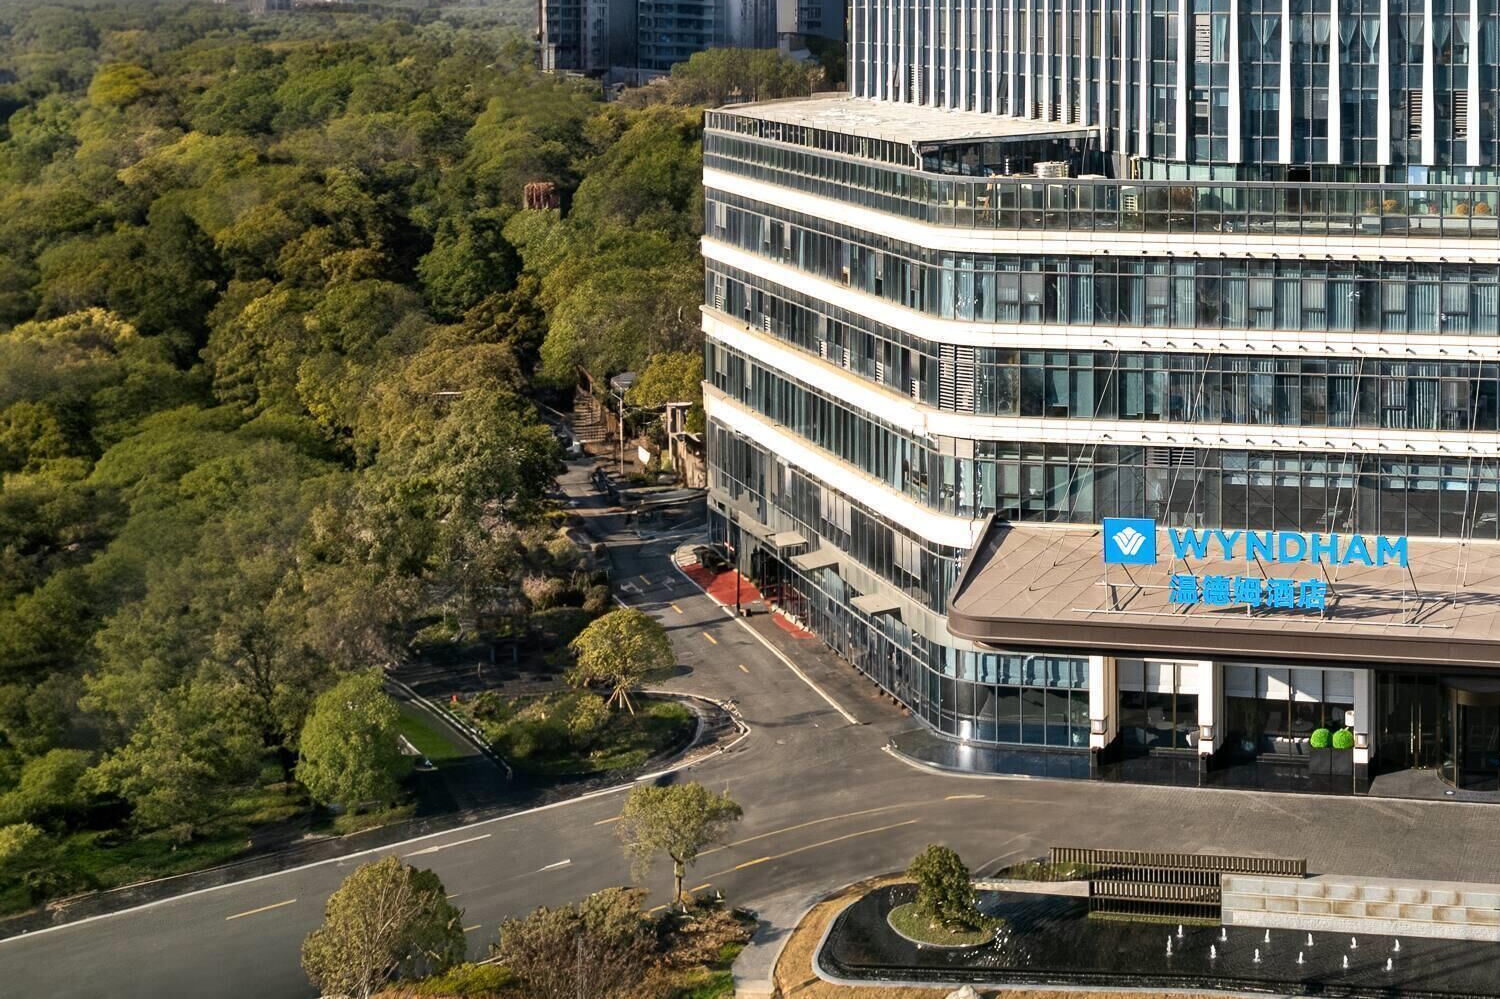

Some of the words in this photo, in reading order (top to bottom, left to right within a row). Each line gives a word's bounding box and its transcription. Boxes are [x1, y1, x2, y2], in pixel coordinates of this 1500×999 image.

[1168, 528, 1408, 568] WYNDHAM
[1168, 574, 1327, 609] 温德姆酒店
